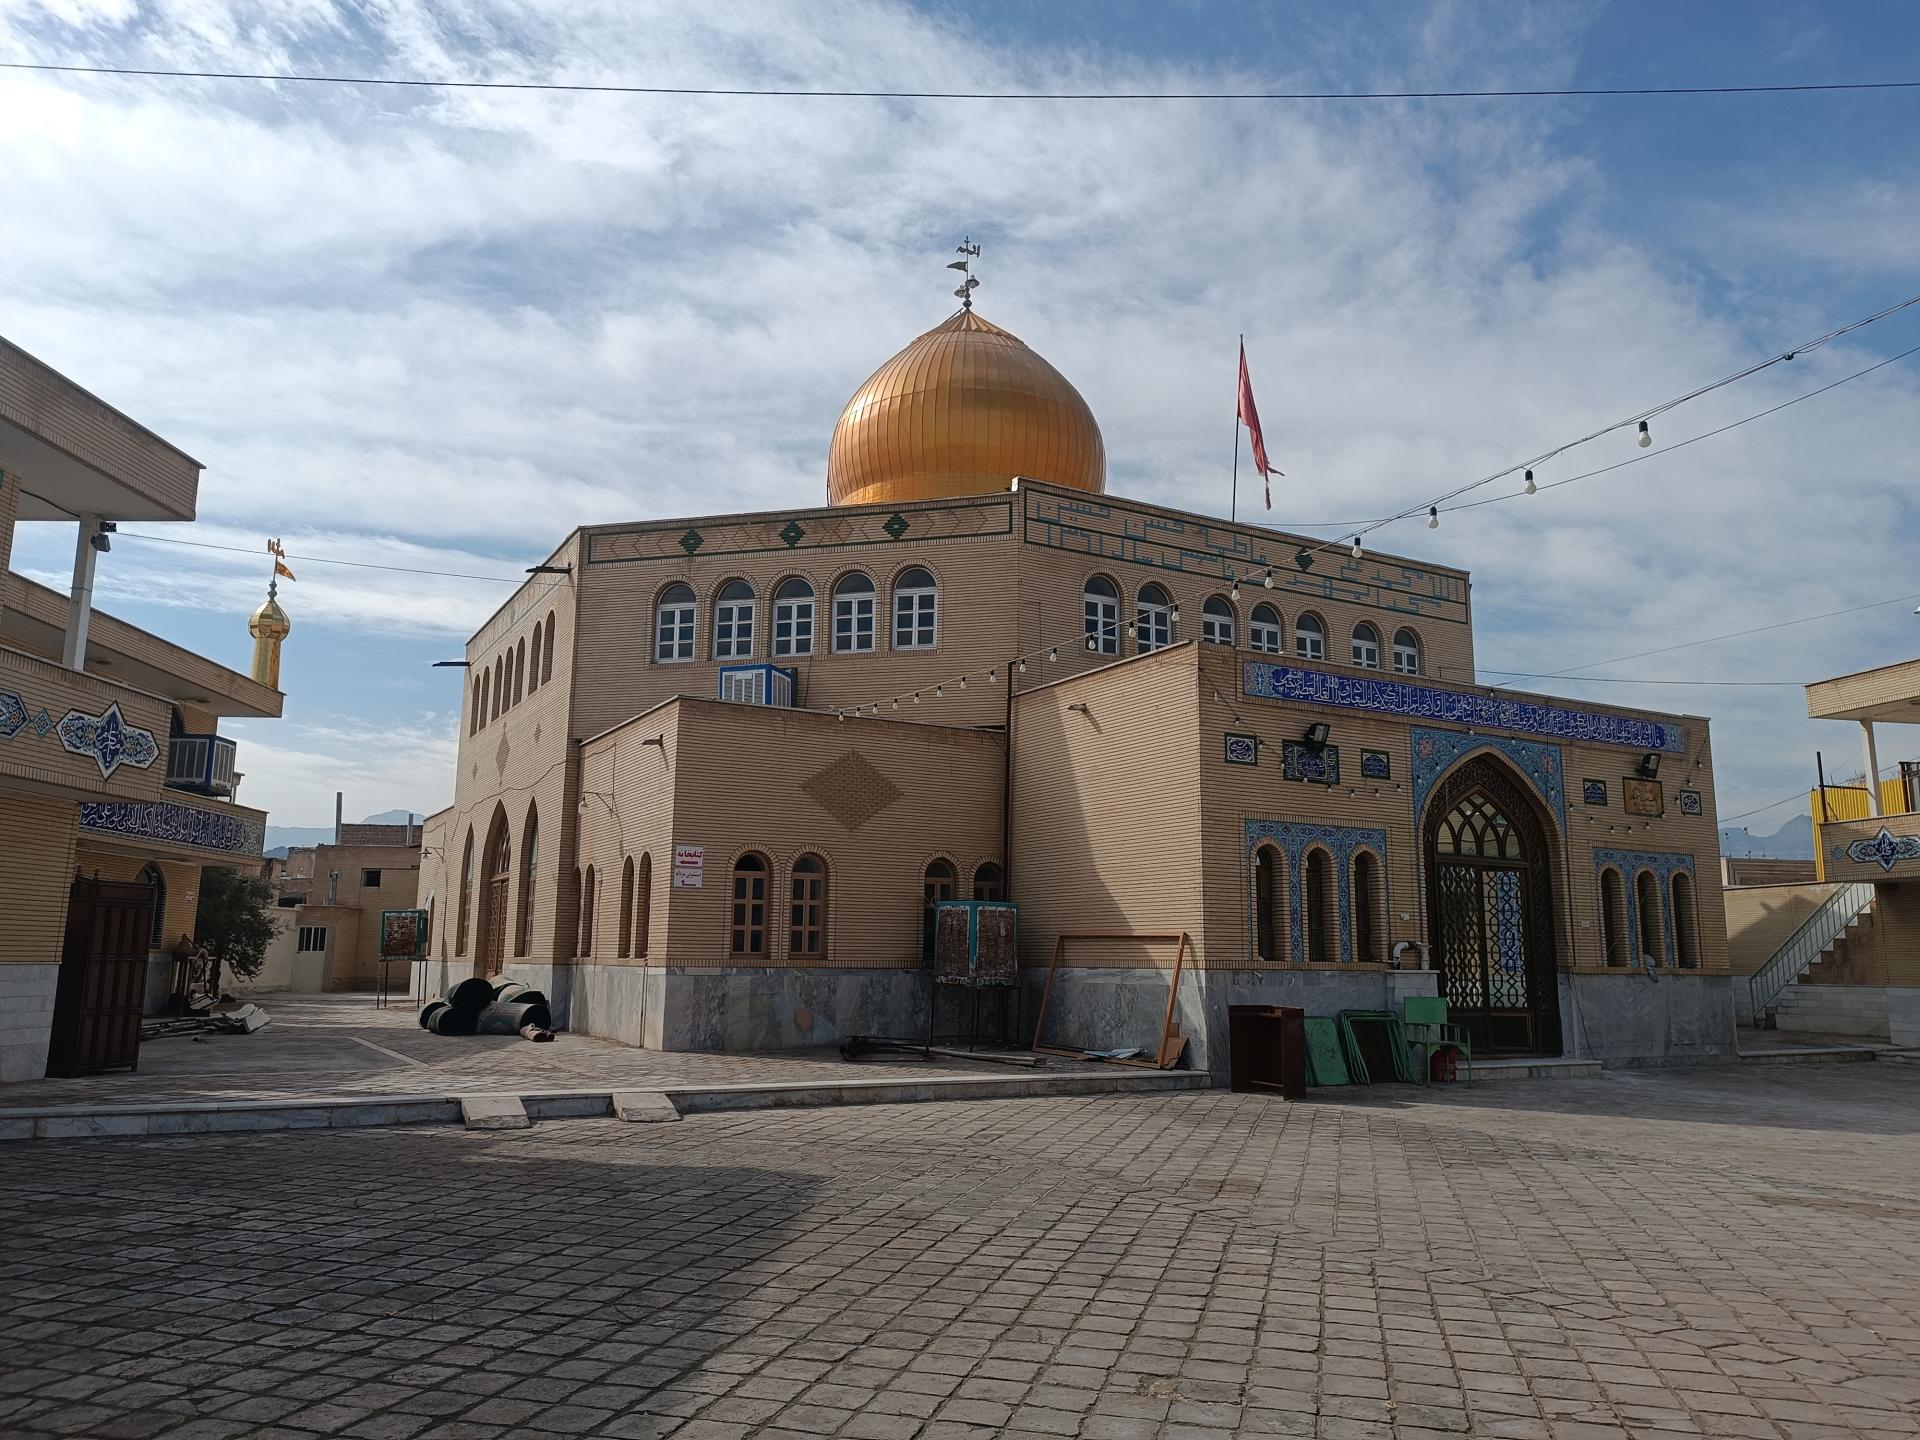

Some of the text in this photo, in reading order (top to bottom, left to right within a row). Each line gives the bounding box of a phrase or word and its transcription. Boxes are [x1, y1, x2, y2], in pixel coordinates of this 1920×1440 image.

[1037, 502, 1111, 526] حسین
[1125, 519, 1185, 542] حسن
[1370, 567, 1424, 589] محمد
[677, 849, 704, 858] کتابخانه
